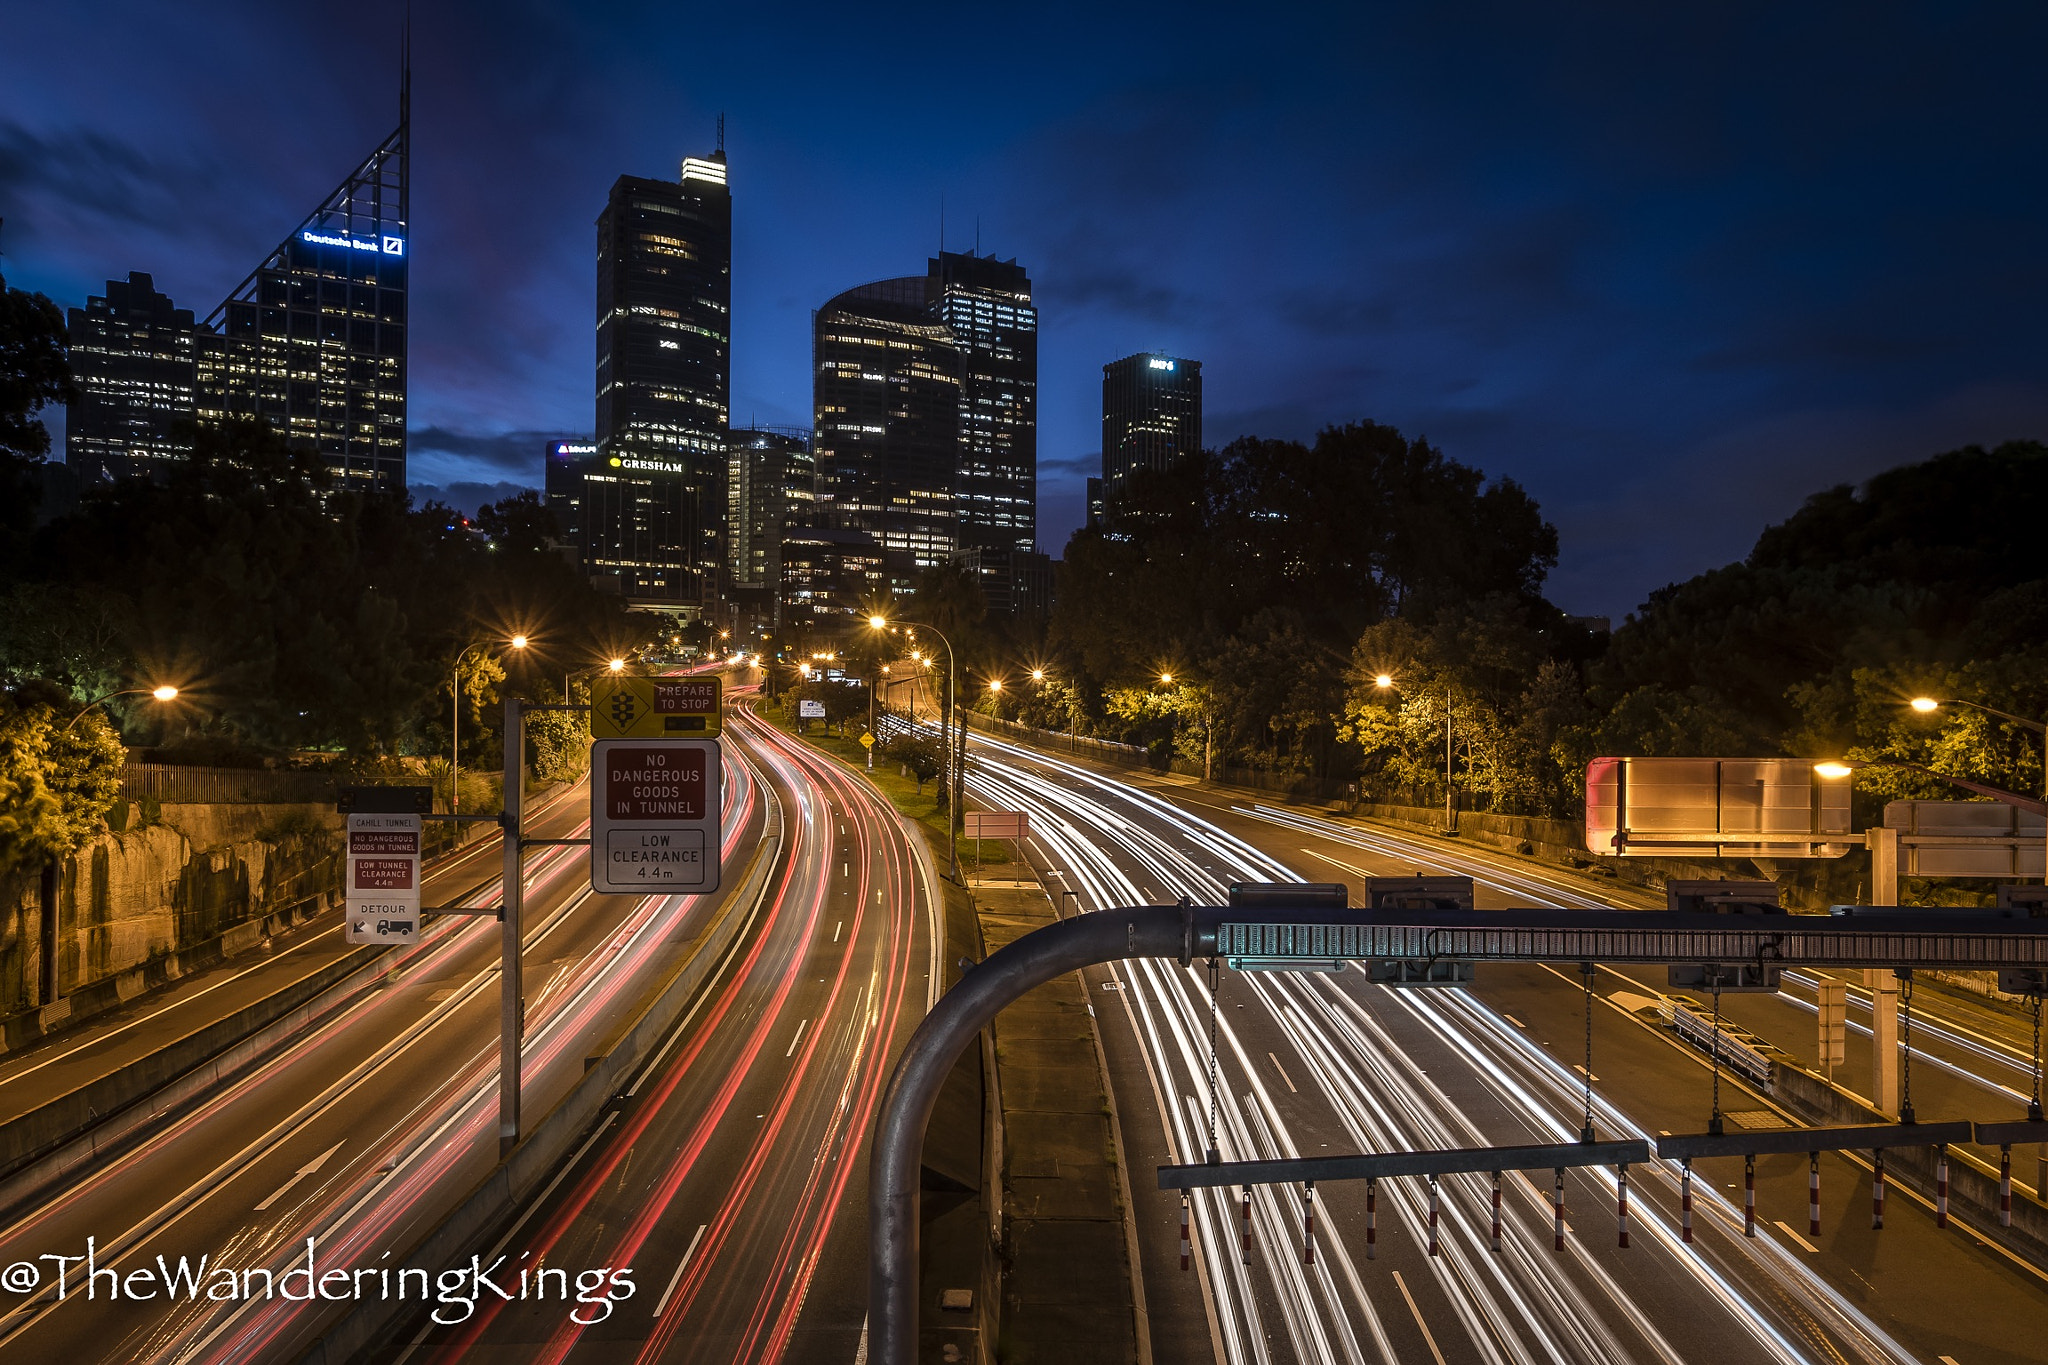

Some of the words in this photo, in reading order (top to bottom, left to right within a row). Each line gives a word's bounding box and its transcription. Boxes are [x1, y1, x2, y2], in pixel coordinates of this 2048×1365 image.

[352, 240, 378, 251] Bank
[622, 460, 682, 472] GRESHAM
[658, 686, 713, 696] PREPARE
[661, 699, 675, 709] TO
[681, 699, 710, 709] STOP
[646, 754, 666, 766] NO
[612, 770, 700, 782] DANGEROUS
[633, 786, 680, 798] GOODS
[617, 801, 630, 813] IN
[640, 801, 695, 813] TUNNEL
[356, 819, 381, 827] CAHILL
[385, 819, 413, 827] TUNNEL
[368, 835, 414, 843] DANGEROUS
[641, 835, 670, 847] LOW
[388, 844, 415, 852] TUNNEL
[613, 851, 698, 863] CLEARANCE
[361, 905, 406, 914] DETOUR
